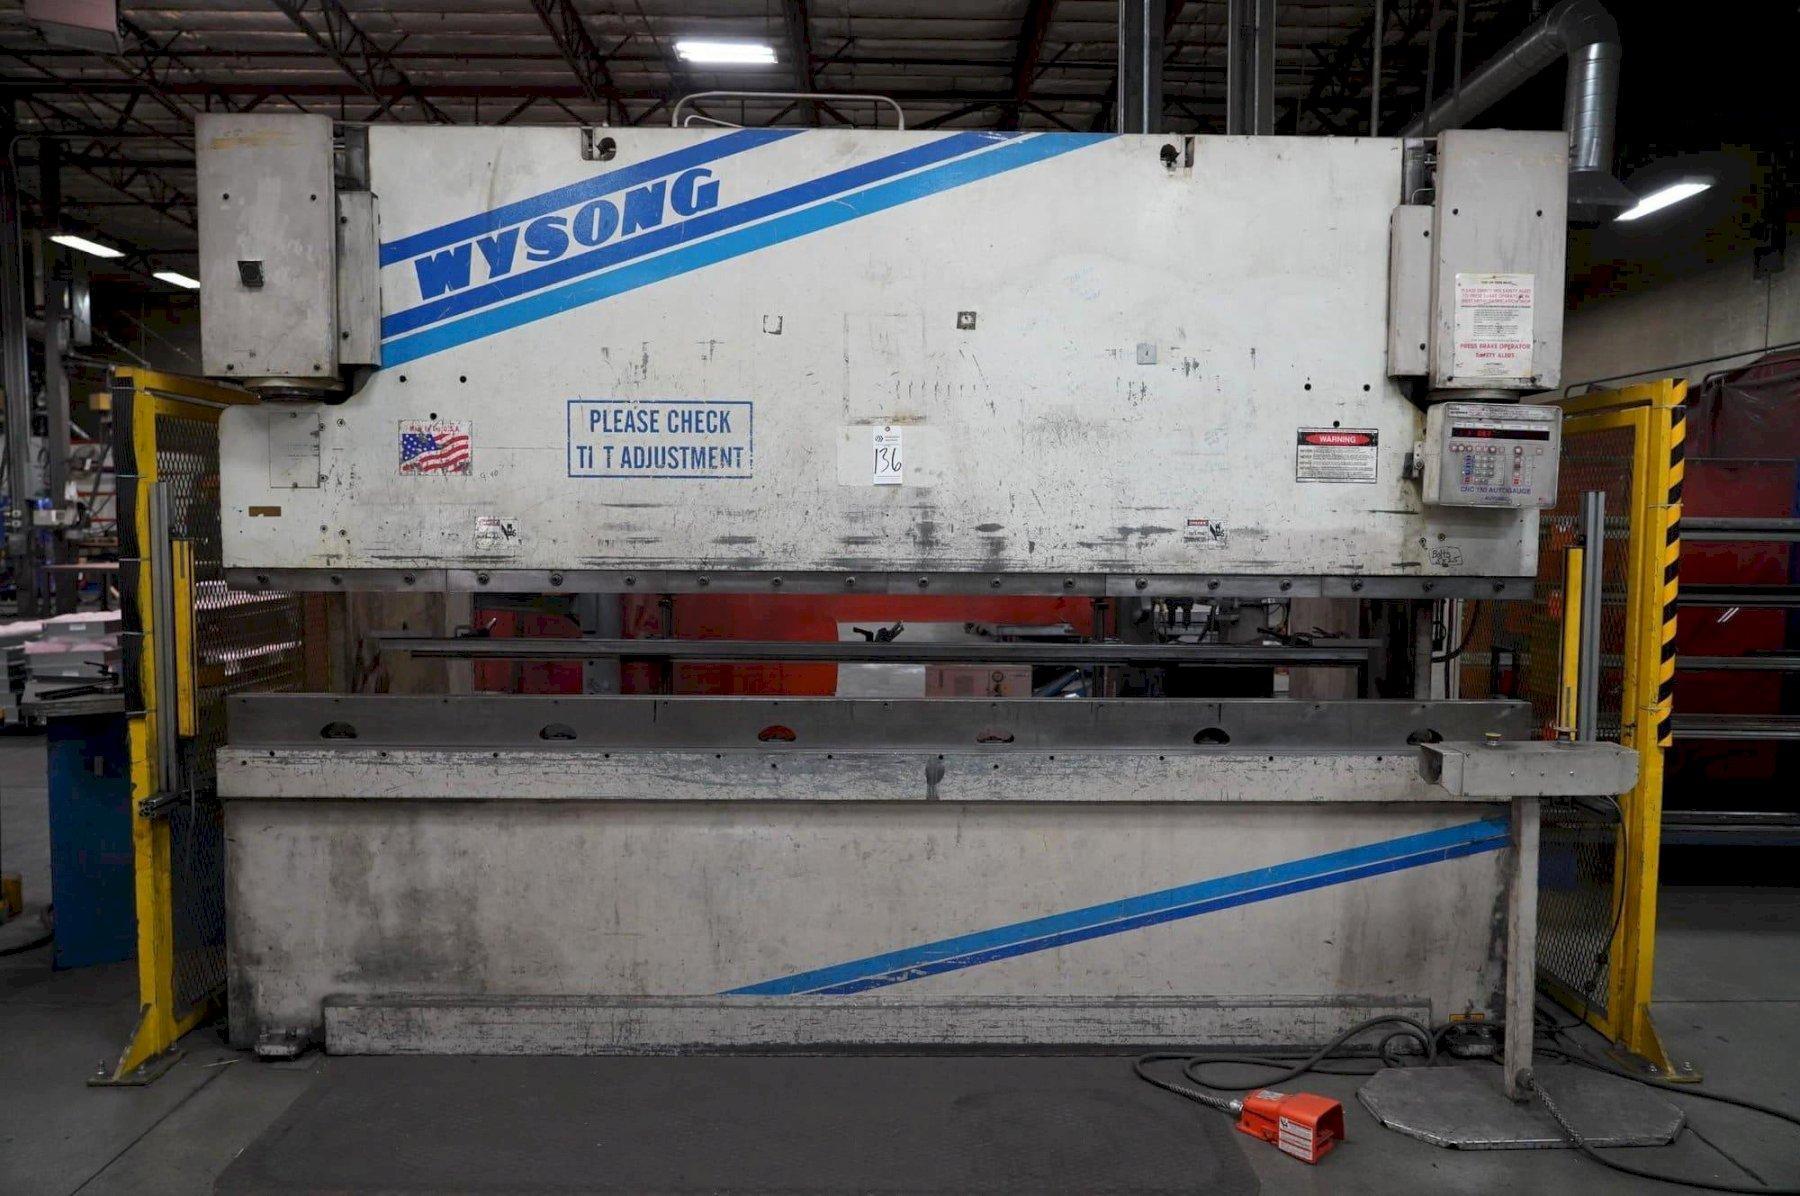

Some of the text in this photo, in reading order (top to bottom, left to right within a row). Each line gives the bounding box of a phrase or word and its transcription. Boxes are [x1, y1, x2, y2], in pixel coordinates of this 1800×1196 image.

[415, 168, 720, 300] WYSONG
[590, 409, 731, 433] PLEASE CHECK
[1319, 435, 1356, 444] WARNING
[576, 446, 744, 469] TIT ADJUSTMENT
[874, 448, 902, 474] 136
